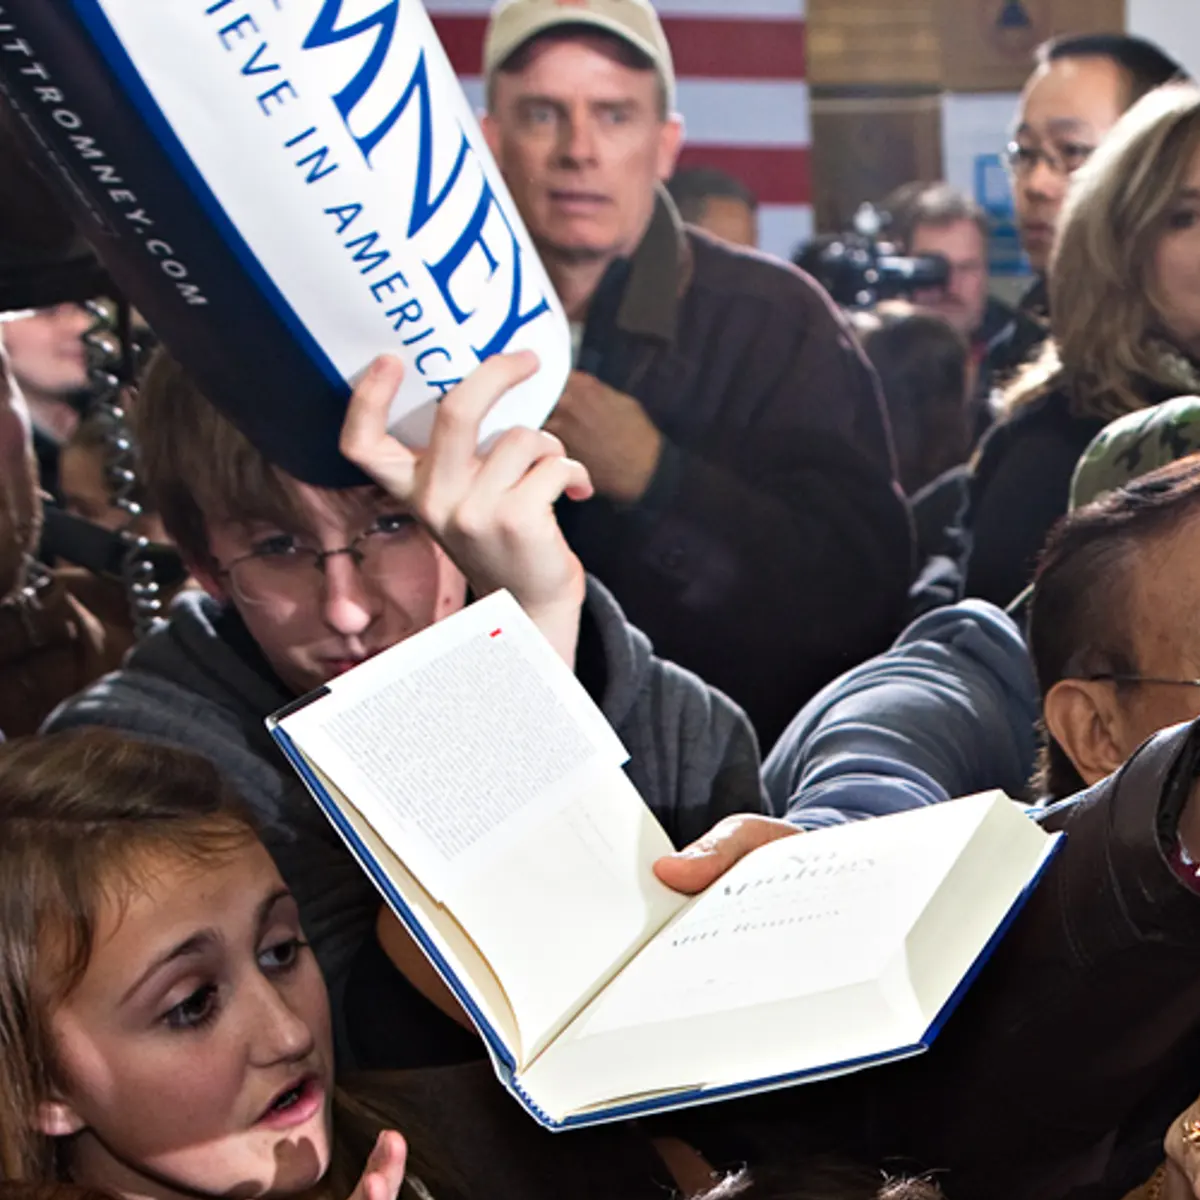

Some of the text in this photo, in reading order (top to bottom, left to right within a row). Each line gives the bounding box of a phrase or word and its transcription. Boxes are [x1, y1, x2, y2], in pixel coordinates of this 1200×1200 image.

[0, 7, 208, 305] ITTROMNEY.COM
[284, 126, 339, 185] IN
[323, 202, 464, 404] AMERICA
